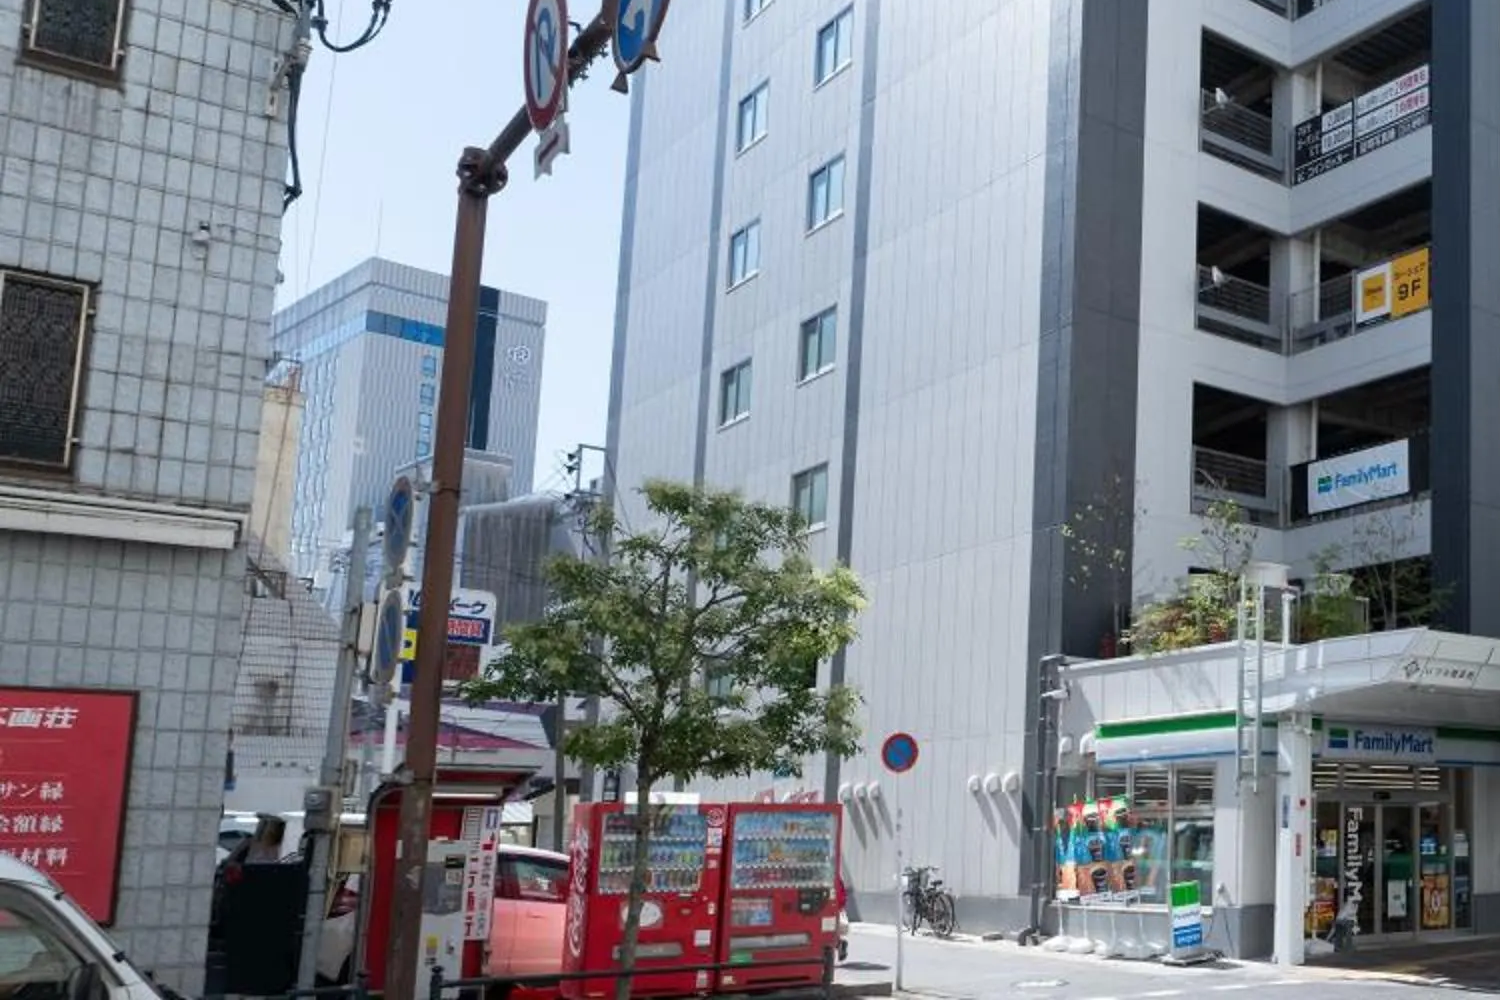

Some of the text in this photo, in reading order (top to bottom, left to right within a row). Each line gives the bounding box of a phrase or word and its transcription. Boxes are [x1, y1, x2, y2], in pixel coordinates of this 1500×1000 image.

[1398, 278, 1421, 301] 9F
[1335, 461, 1397, 489] FamilyMart
[1354, 729, 1434, 755] FamilyMart
[10, 846, 69, 867] 材料
